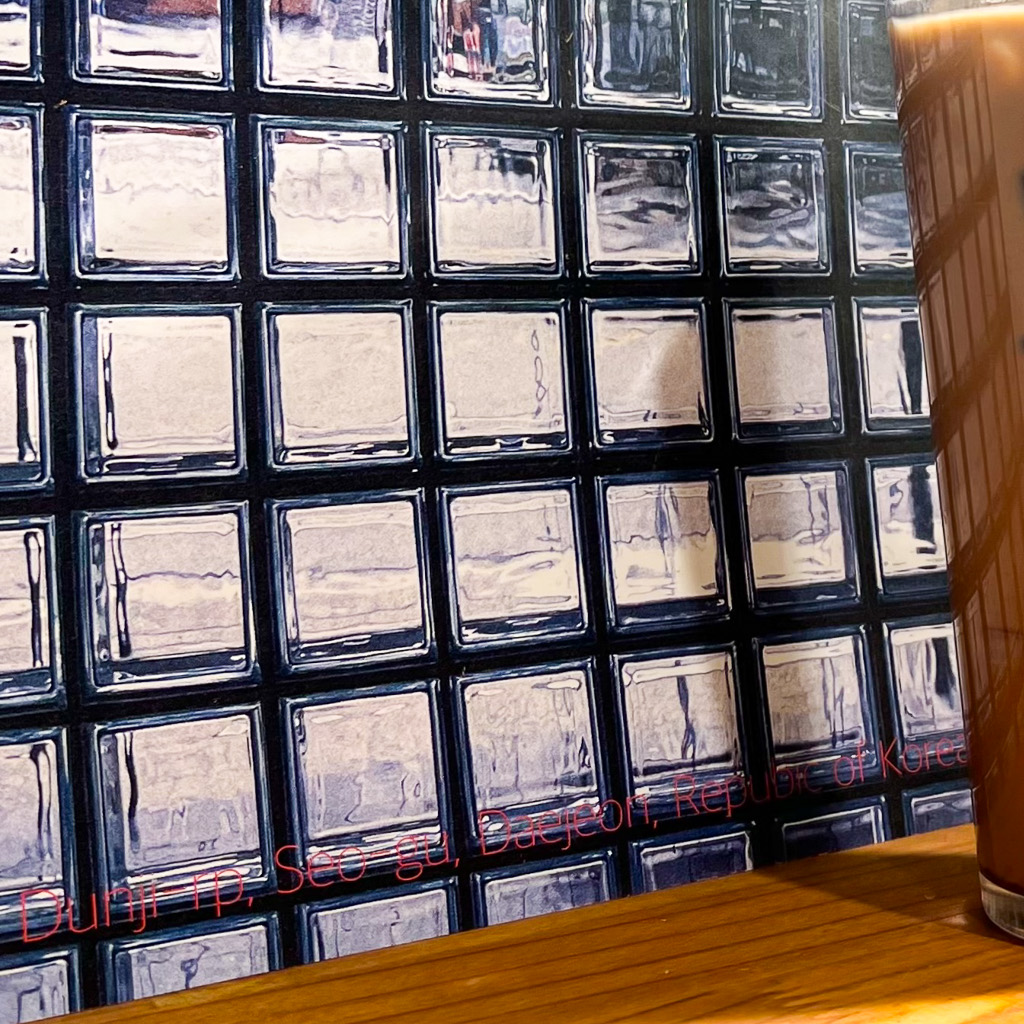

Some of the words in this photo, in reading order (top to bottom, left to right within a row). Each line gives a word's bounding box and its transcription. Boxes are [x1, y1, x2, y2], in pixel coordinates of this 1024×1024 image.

[274, 830, 460, 894] Seo-gu,
[478, 793, 658, 856] Daejeon,
[833, 739, 866, 788] of
